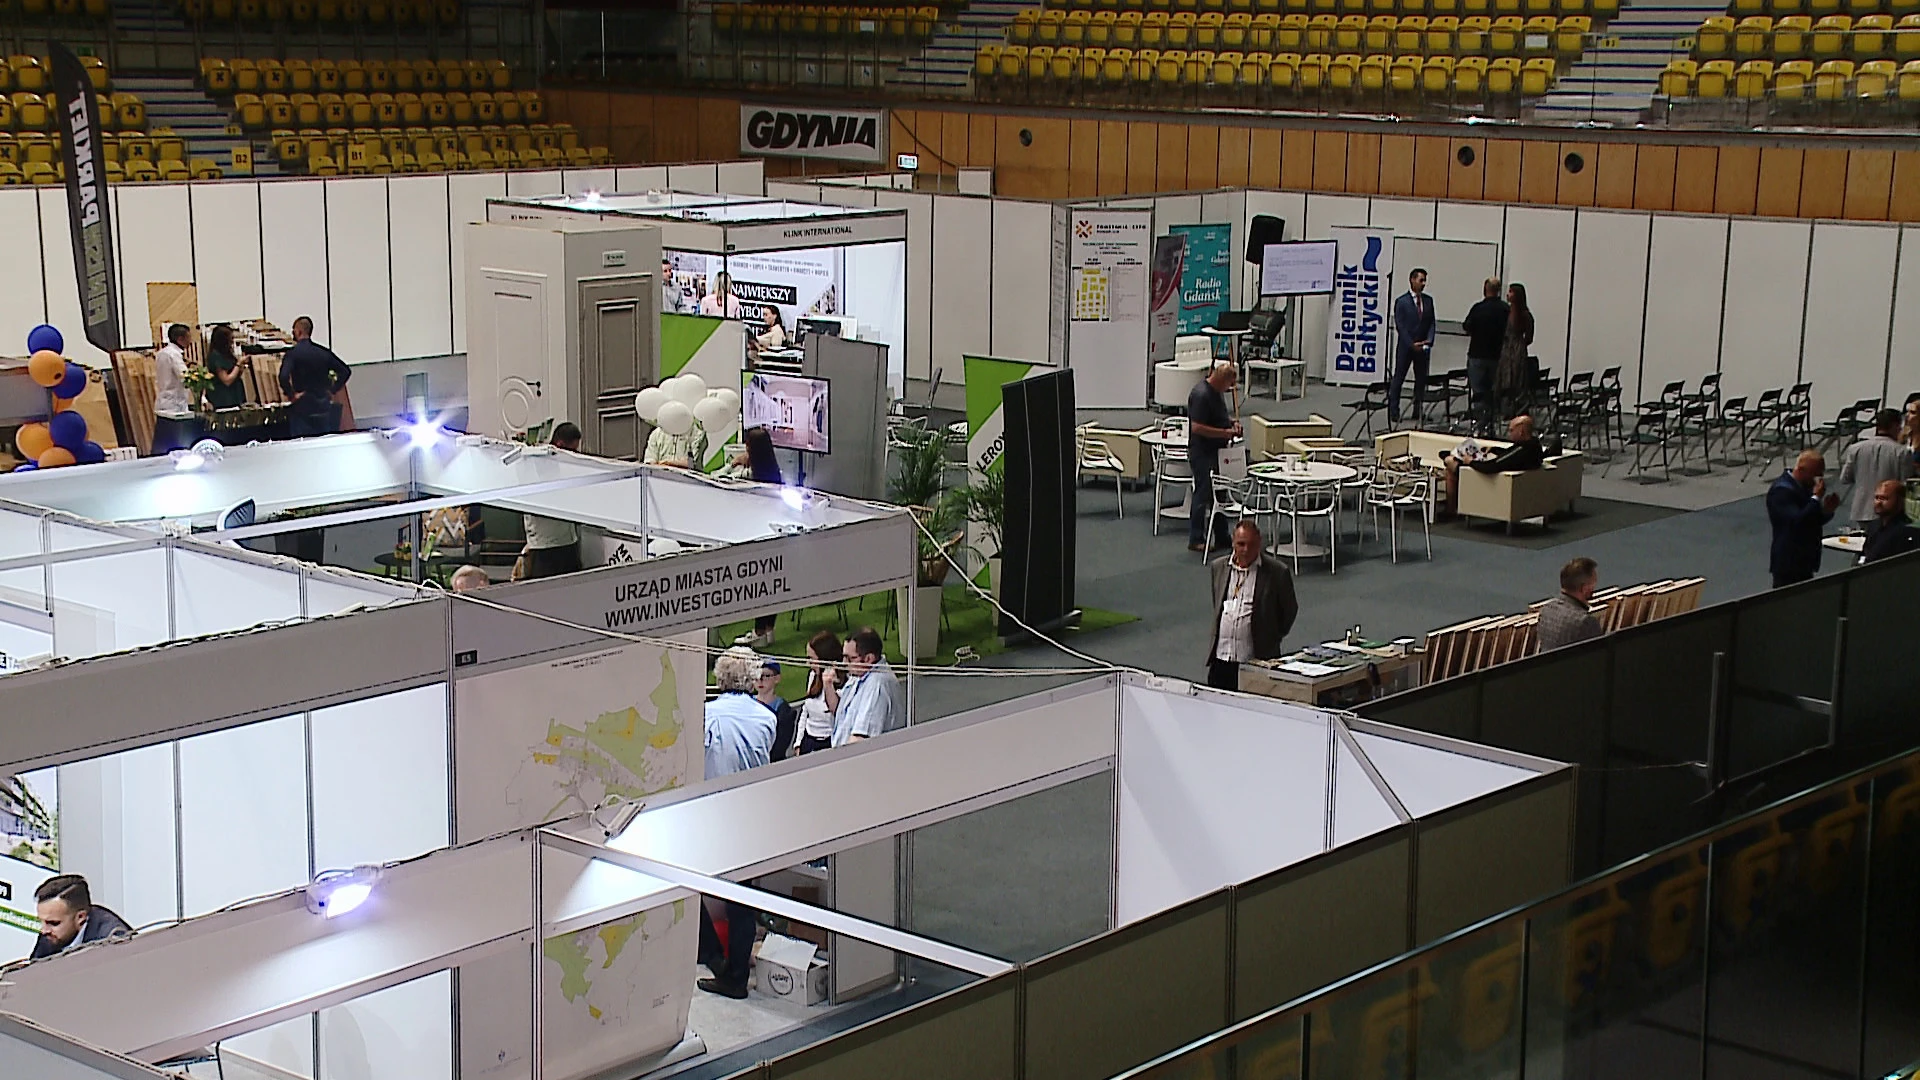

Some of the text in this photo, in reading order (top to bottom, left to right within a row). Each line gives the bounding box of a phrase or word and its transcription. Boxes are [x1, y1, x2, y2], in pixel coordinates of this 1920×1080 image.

[747, 110, 876, 150] GDYNIA
[804, 225, 852, 236] INTERNATIONAL
[731, 283, 791, 302] NAJWIĘKSZY
[1184, 288, 1221, 303] Gdańsk
[1195, 278, 1221, 290] Radio
[1335, 264, 1358, 372] Dziennik
[1357, 274, 1383, 373] Bałtycki
[615, 555, 784, 603] URZĄD MIASTA GDYNI
[605, 576, 792, 628] WWW.INVESTGDYNIA.PL
